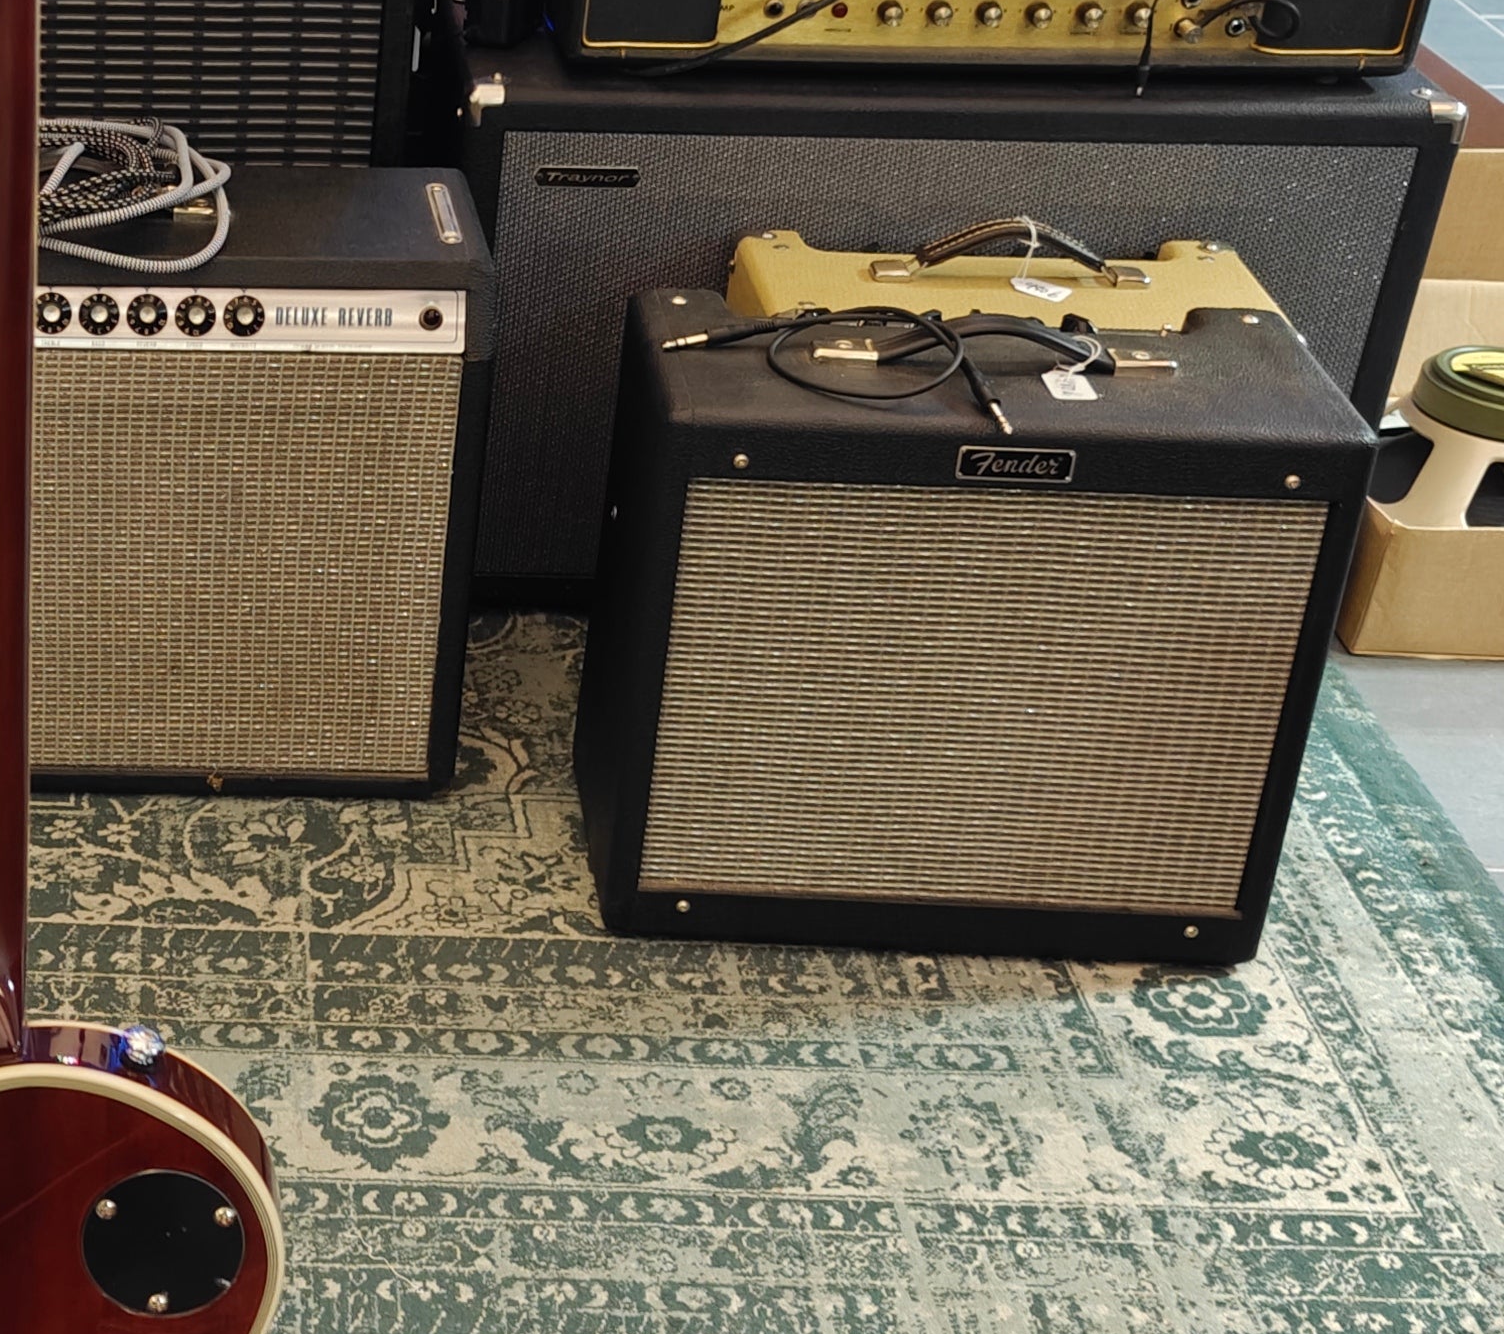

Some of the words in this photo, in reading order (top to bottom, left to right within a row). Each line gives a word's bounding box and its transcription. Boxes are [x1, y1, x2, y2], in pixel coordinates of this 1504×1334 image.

[546, 171, 630, 185] Traynor
[275, 306, 328, 326] DELUXE
[338, 307, 393, 327] REVERB
[970, 452, 1060, 476] Fender
